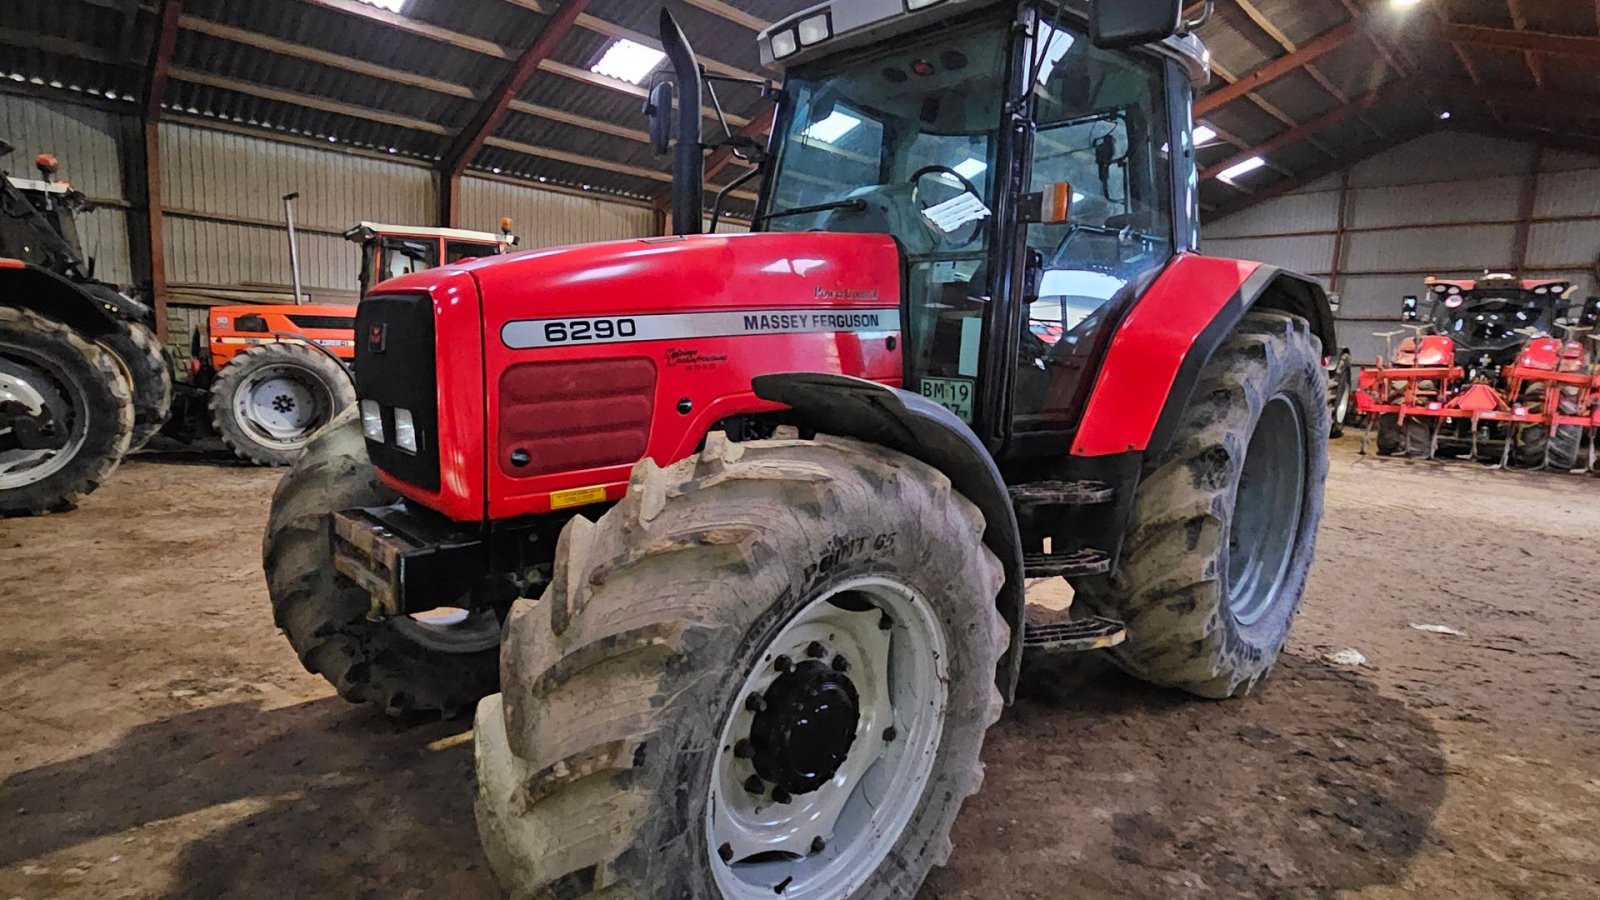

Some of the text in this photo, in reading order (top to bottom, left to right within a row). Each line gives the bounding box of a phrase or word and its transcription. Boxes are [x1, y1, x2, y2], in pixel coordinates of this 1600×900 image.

[544, 318, 636, 343] 6290
[743, 313, 880, 330] MASSEY FERGUSON
[923, 382, 969, 402] BM 19
